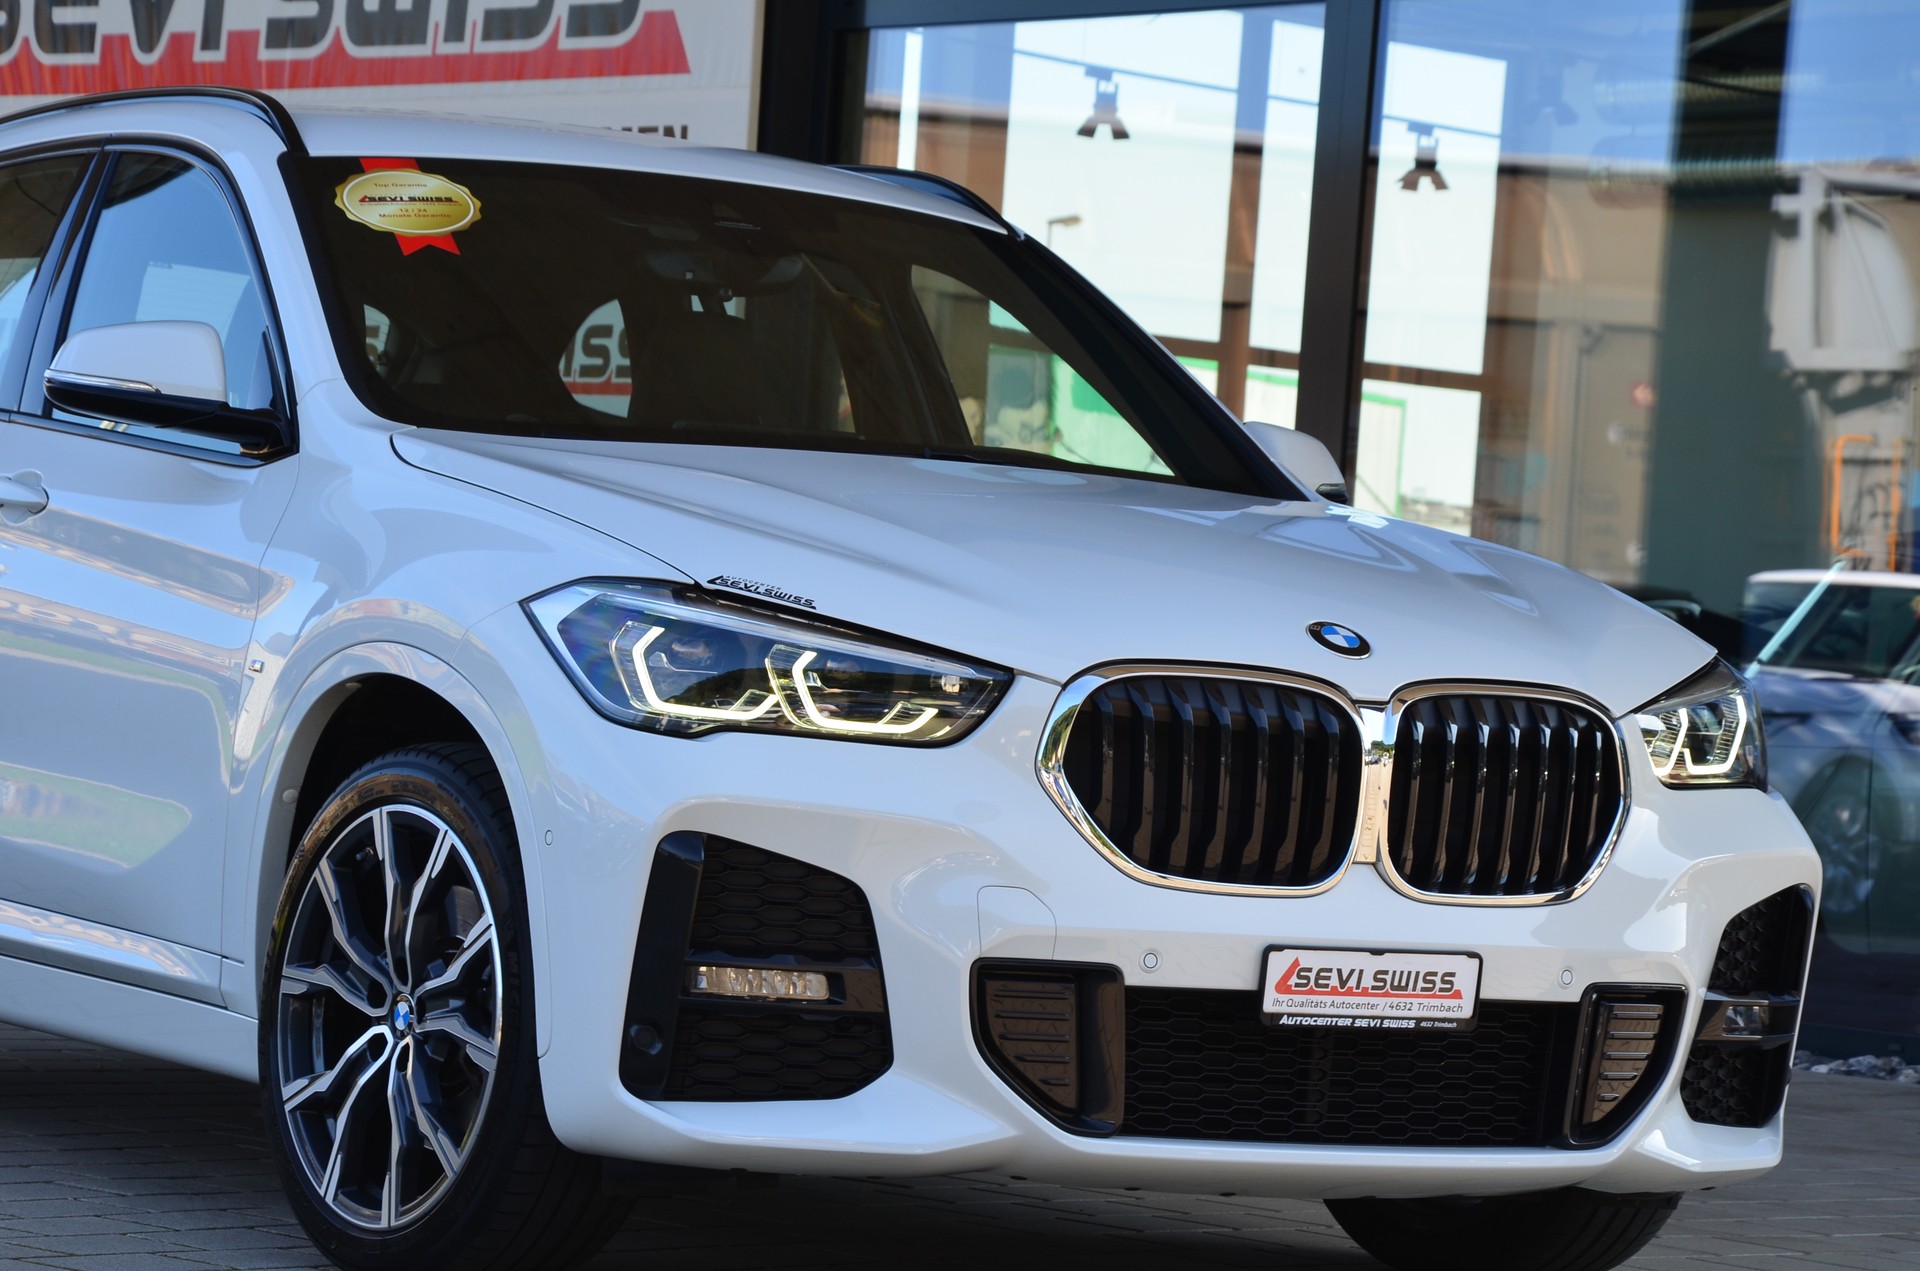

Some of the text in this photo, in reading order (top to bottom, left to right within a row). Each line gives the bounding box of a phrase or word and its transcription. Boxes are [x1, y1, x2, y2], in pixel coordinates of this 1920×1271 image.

[726, 575, 782, 590] AUTOCENTER
[717, 577, 815, 607] SEVI SWISS
[1294, 966, 1457, 994] SEVI SWISS
[1272, 997, 1285, 1008] Ihr
[1329, 1000, 1380, 1010] Autocenter
[1388, 1001, 1413, 1011] 4632
[1417, 1002, 1463, 1013] Trimbach
[1279, 1014, 1353, 1026] AUTOCENTER
[1353, 1018, 1381, 1027] SEVI
[1382, 1019, 1416, 1028] SWISS
